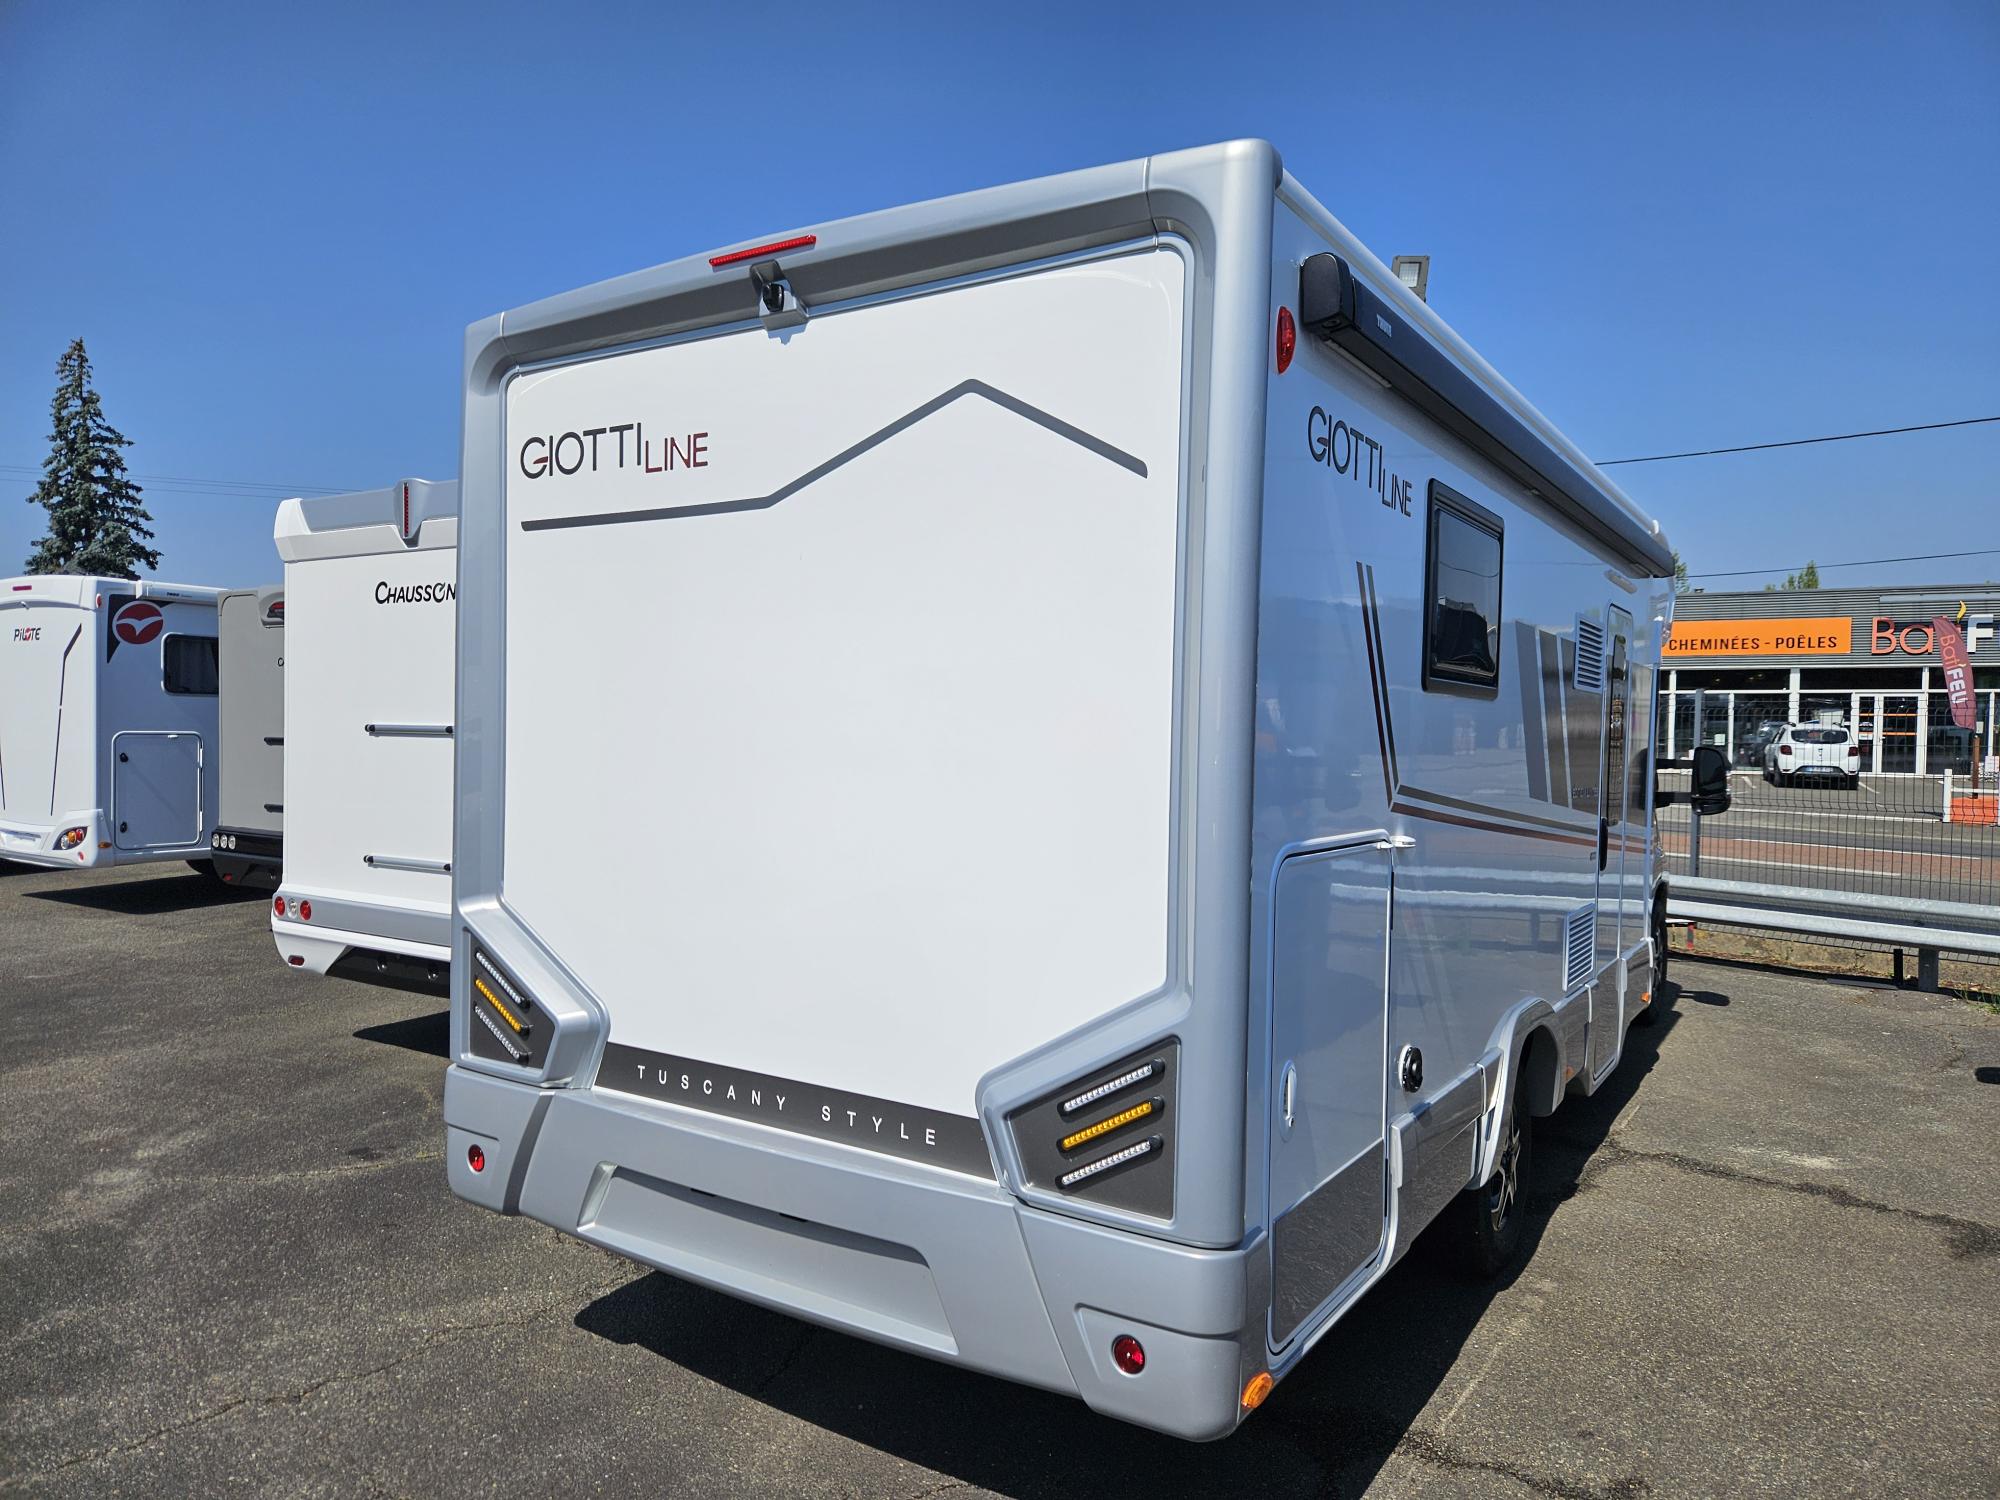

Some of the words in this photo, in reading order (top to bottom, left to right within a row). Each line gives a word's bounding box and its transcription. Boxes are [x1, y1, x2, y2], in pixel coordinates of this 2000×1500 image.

[1668, 636, 1760, 650] CHEMINÉES
[1775, 634, 1838, 649] POÊLES
[637, 1065, 786, 1111] TUSCANY
[821, 1105, 936, 1146] STYLE
